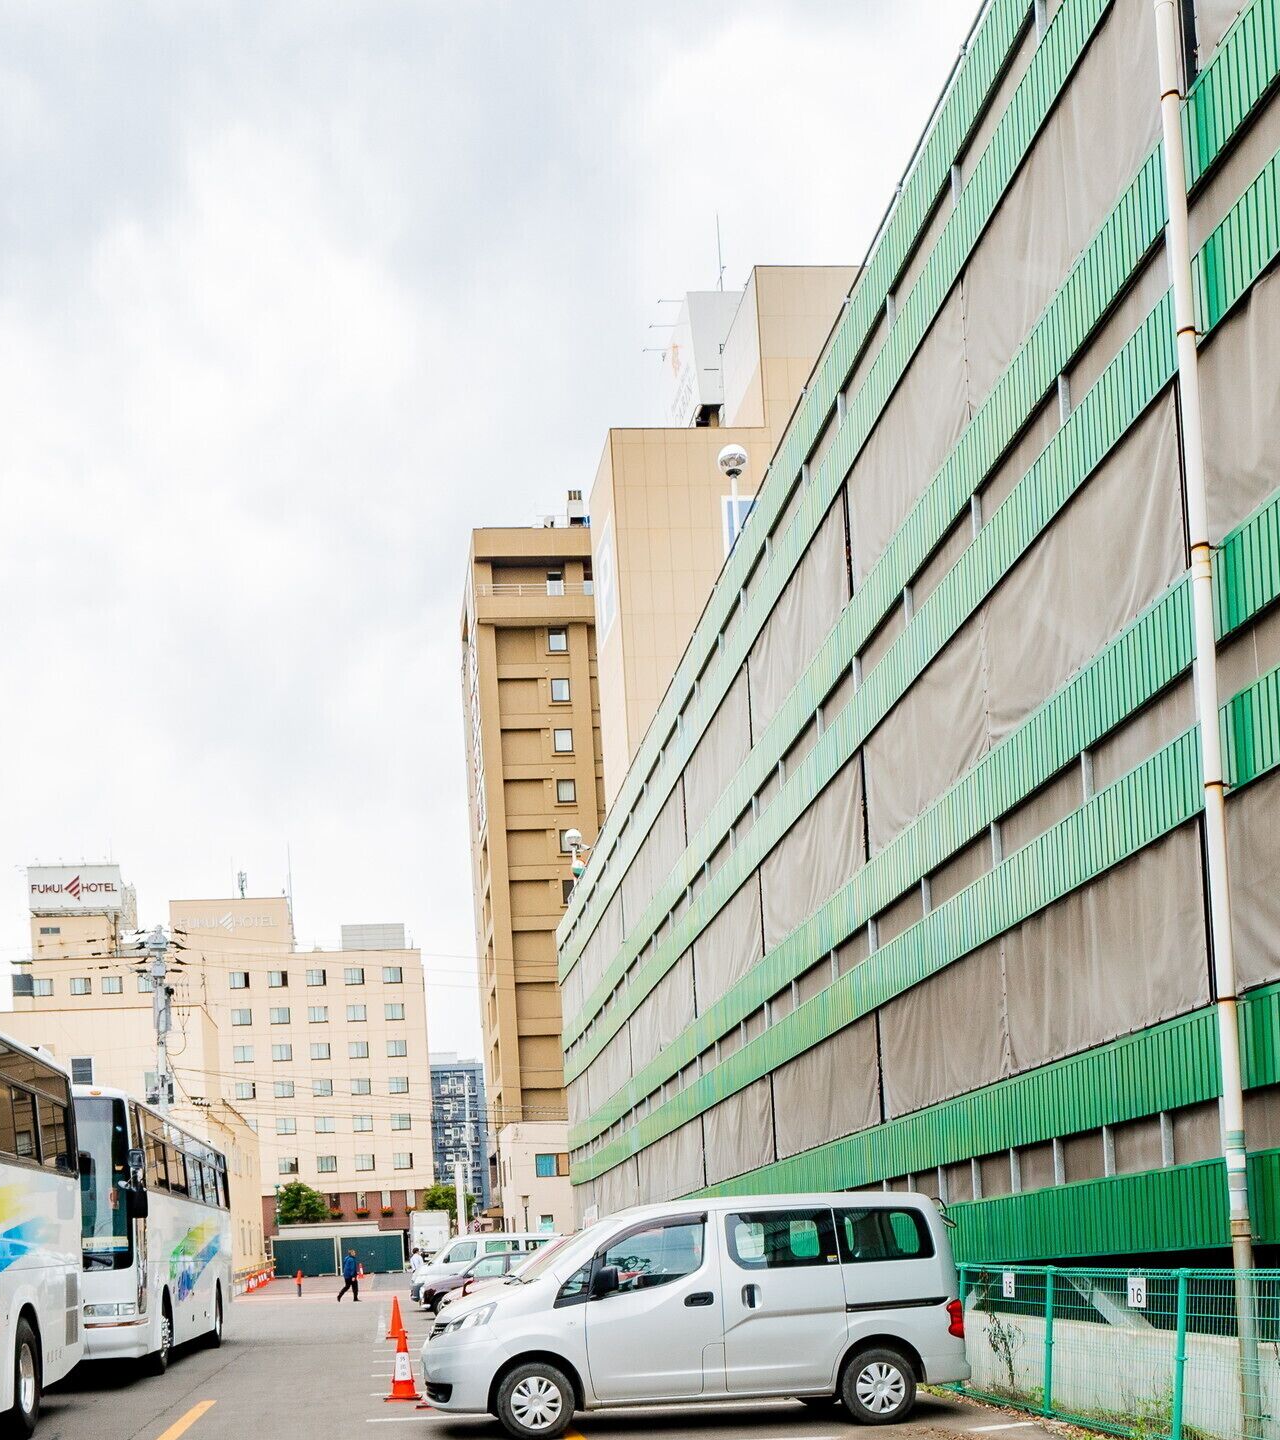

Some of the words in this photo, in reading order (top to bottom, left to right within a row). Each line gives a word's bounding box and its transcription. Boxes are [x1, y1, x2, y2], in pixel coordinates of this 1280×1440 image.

[30, 884, 63, 894] FUKUI
[81, 882, 118, 893] HOTEL
[234, 915, 280, 929] HOTEL
[1005, 1281, 1013, 1294] 15
[1131, 1287, 1143, 1304] 16
